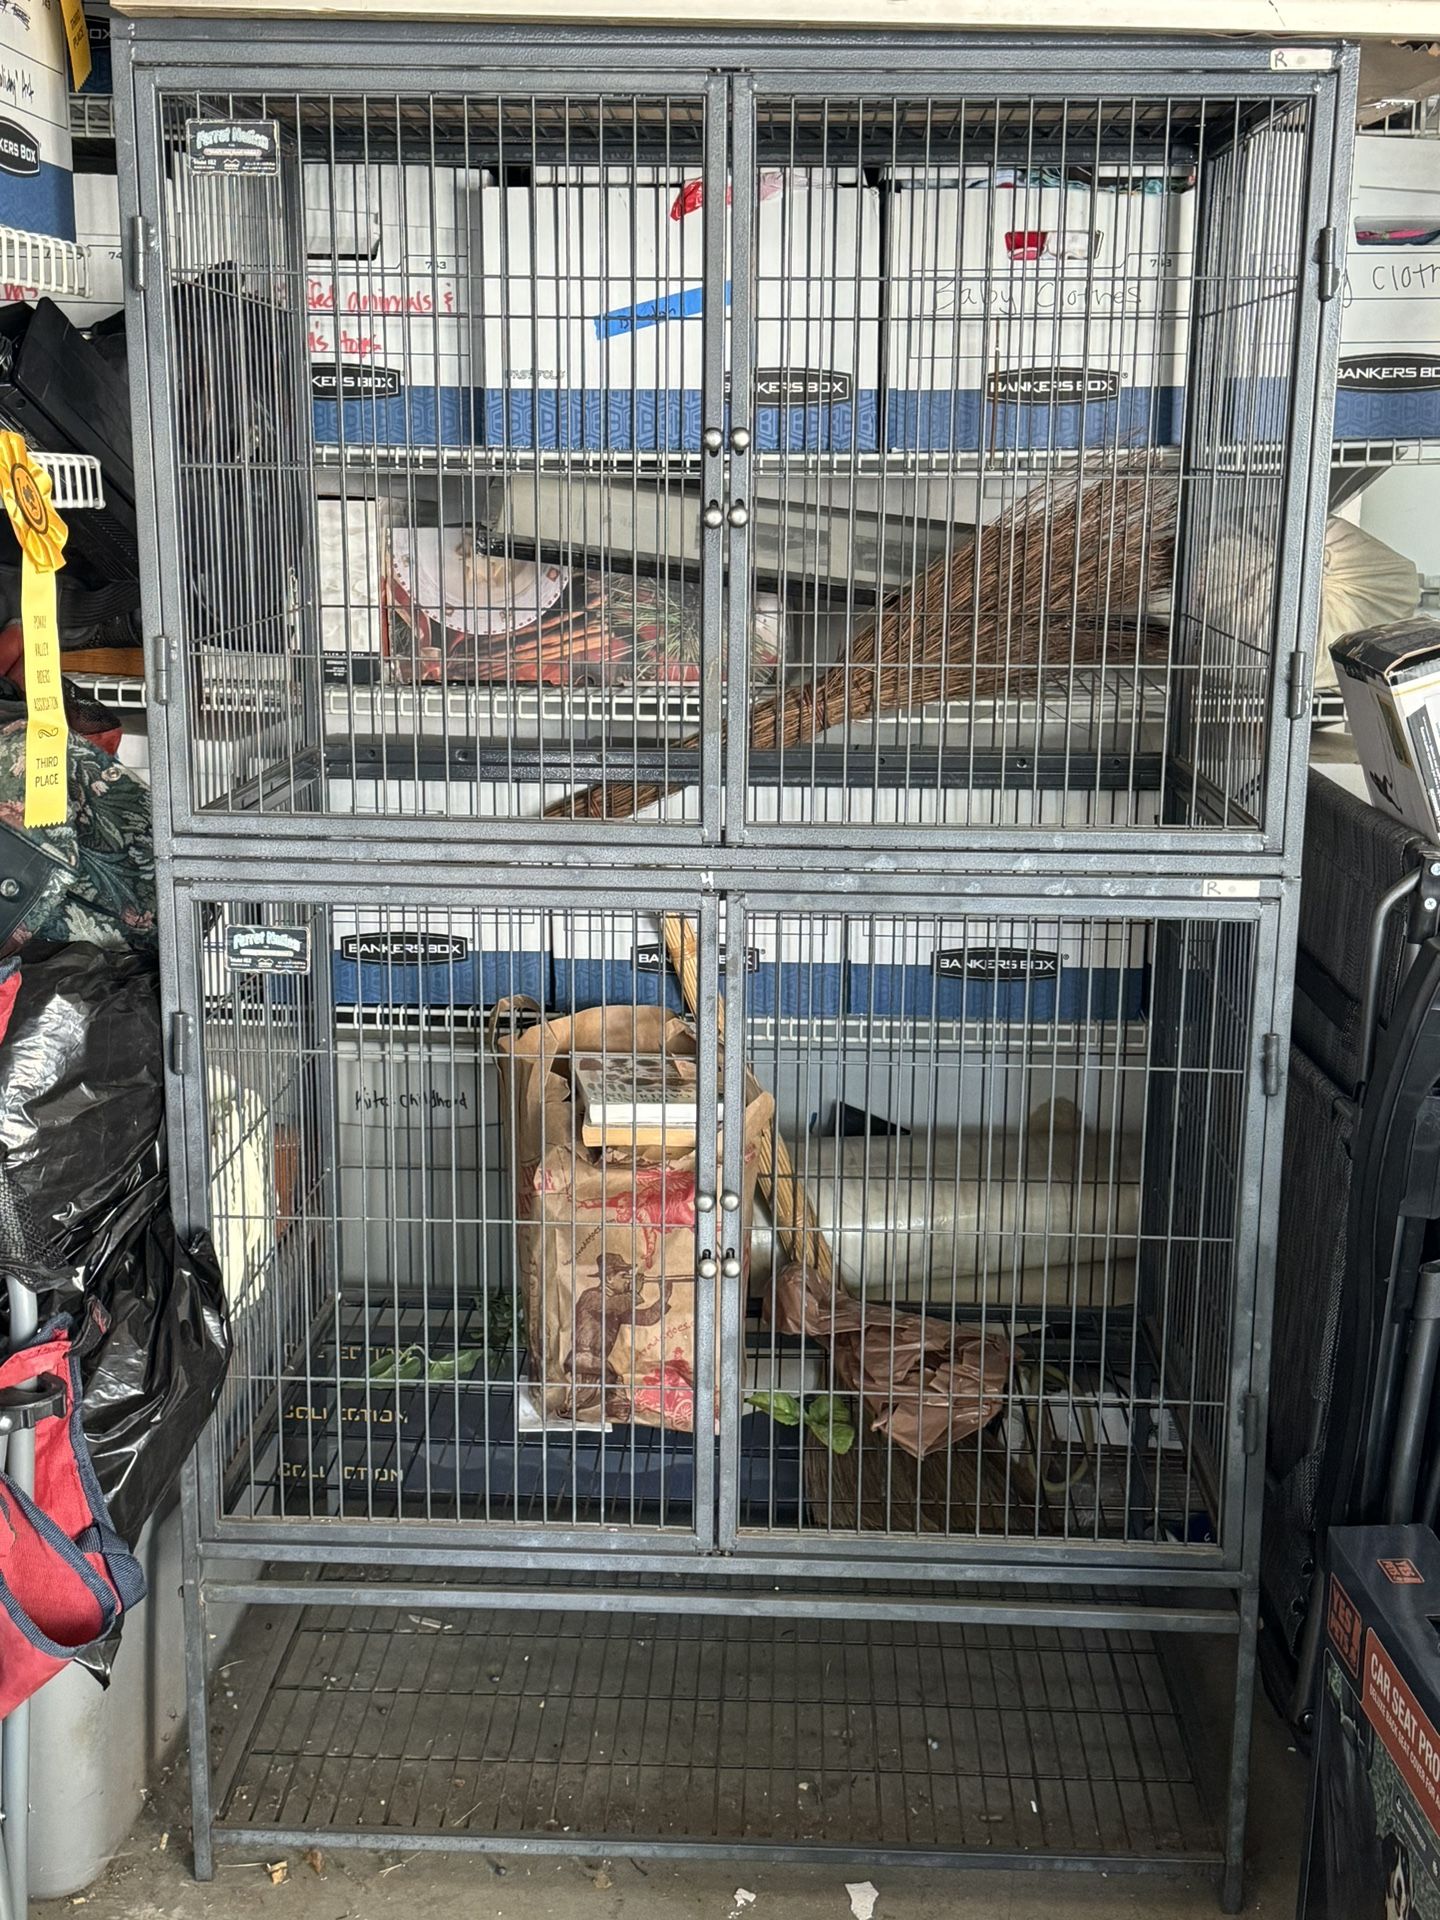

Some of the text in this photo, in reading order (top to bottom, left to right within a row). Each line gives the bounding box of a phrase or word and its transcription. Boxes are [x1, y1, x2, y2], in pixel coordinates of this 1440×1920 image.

[1274, 50, 1288, 68] R
[20, 143, 37, 164] BOX
[425, 261, 447, 269] 73
[1337, 367, 1417, 380] BANKERS
[357, 376, 394, 388] BOX
[808, 382, 845, 393] BOX
[990, 379, 1114, 393] BANKERS BOX
[36, 756, 59, 770] THIRD
[35, 773, 59, 788] PLACE
[1207, 880, 1222, 895] R
[348, 943, 462, 955] BANKERS BOX
[940, 958, 1056, 970] BANKERS BOX
[1370, 1652, 1440, 1783] CAR SEAT PRO
[1385, 1710, 1398, 1738] BACK
[1397, 1731, 1410, 1758] SEAT
[1409, 1751, 1425, 1784] COVER
[1425, 1776, 1436, 1801] FOR
